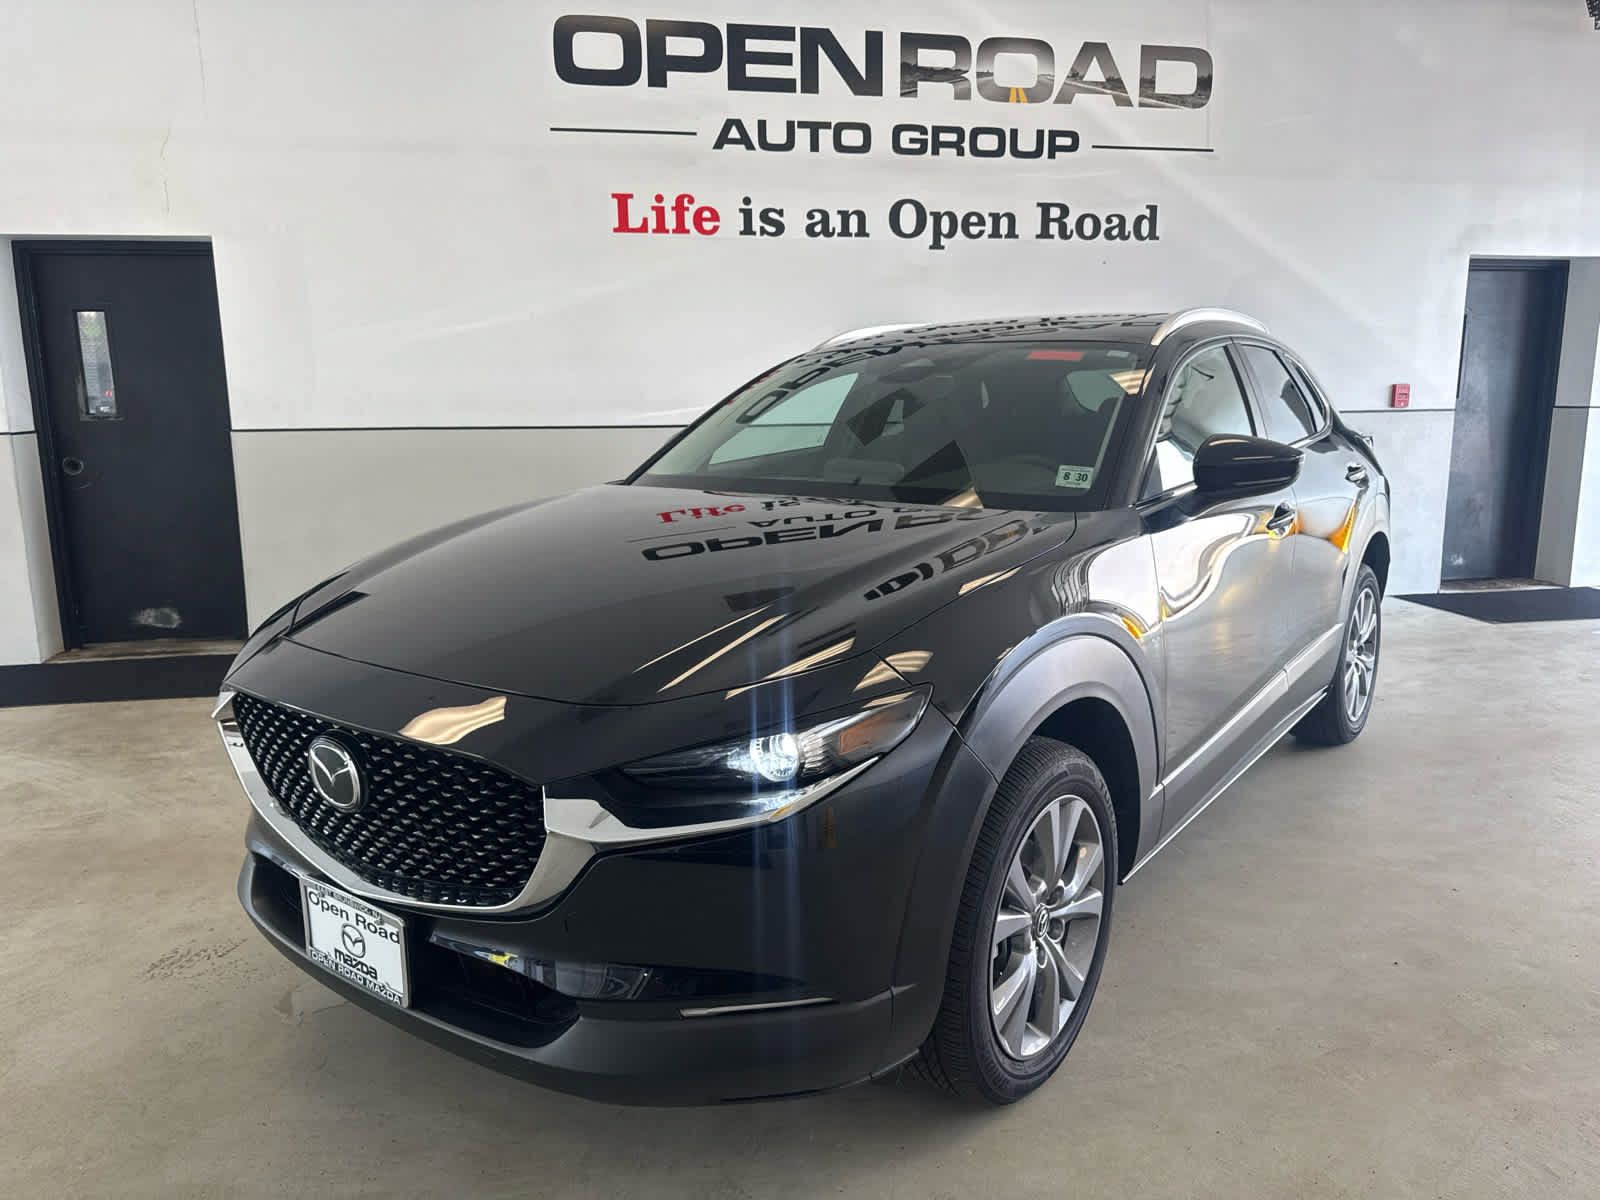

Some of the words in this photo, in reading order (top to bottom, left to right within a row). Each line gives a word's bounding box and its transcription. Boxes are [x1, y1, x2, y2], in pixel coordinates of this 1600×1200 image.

[553, 14, 883, 97] OPEN
[899, 31, 1214, 109] ROAD
[712, 118, 872, 154] AUTO
[891, 123, 1080, 160] GROUP
[611, 191, 721, 237] Life
[738, 196, 785, 238] is
[805, 208, 870, 239] an
[888, 198, 1020, 250] Open
[1035, 202, 1160, 242] Road
[1063, 471, 1071, 481] 8
[1075, 472, 1089, 482] 30
[308, 890, 350, 921] Open
[355, 913, 401, 945] Road
[311, 951, 336, 971] OPEN
[339, 963, 364, 985] ROAD
[366, 979, 402, 1006] MAZDA
